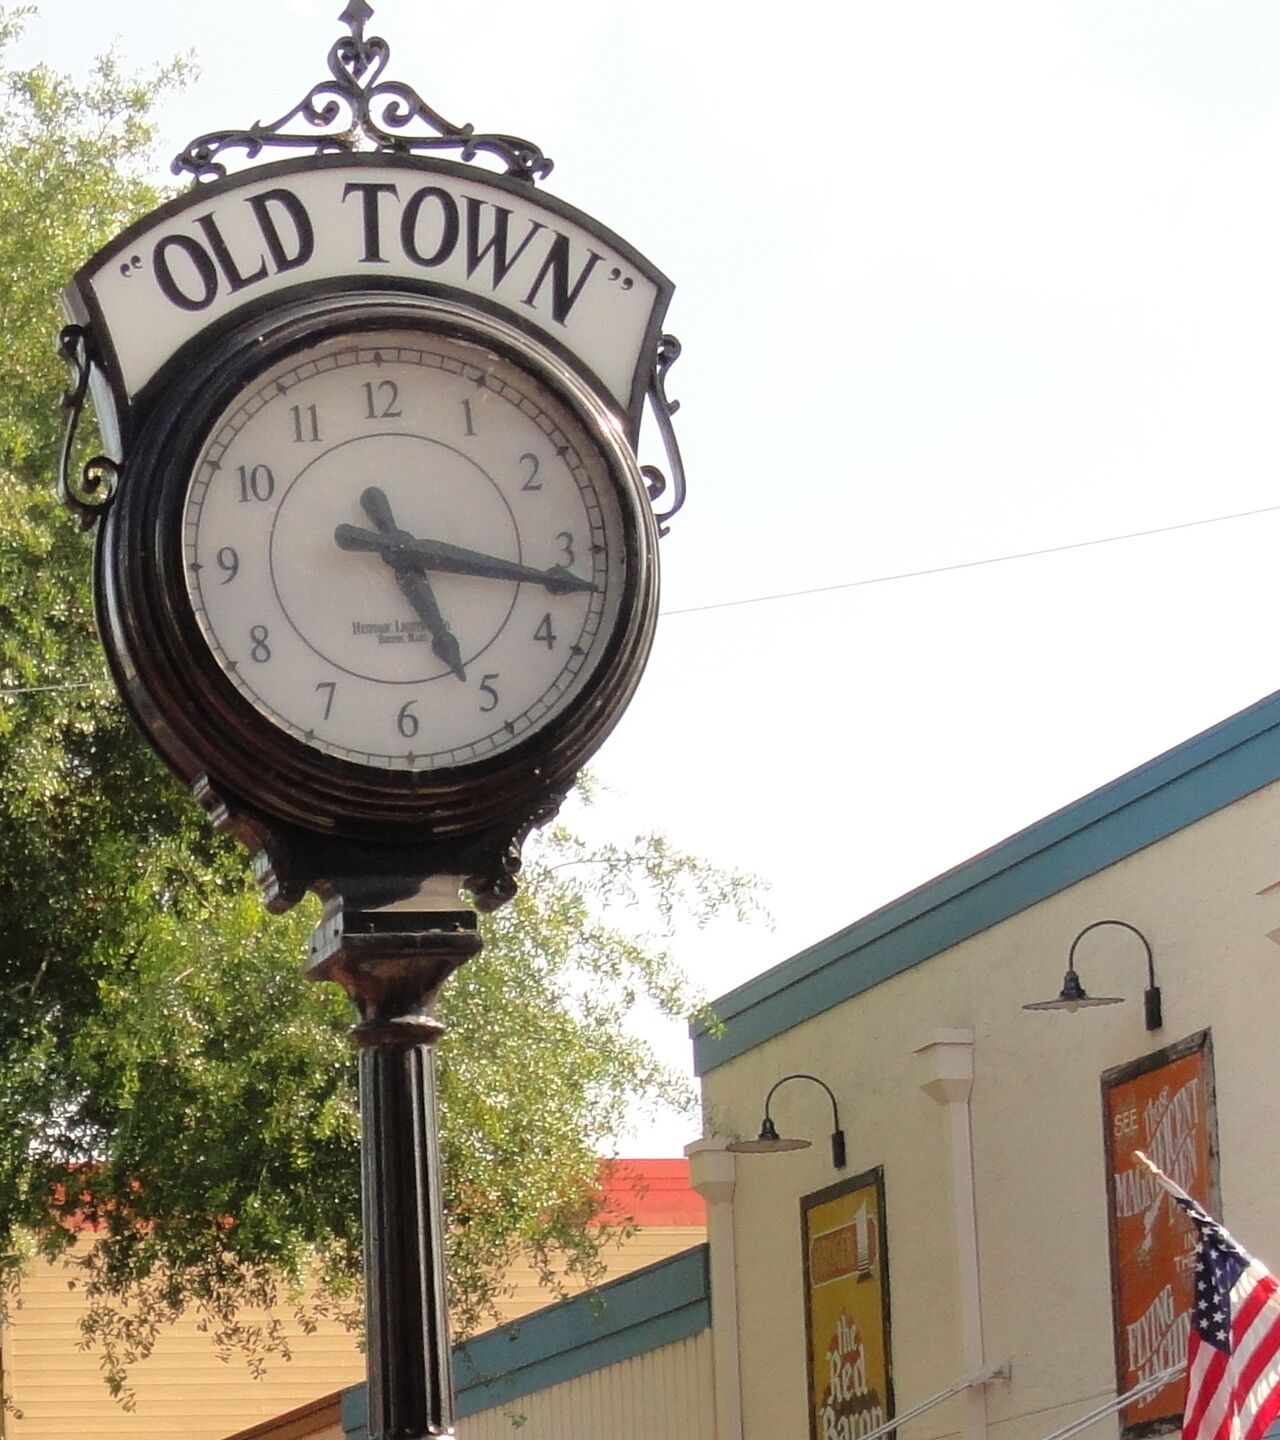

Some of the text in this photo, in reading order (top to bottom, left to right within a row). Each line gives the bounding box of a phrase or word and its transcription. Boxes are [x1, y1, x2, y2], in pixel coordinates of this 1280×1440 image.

[361, 379, 403, 420] 12
[462, 398, 478, 437] 1
[290, 403, 323, 443] 11
[236, 463, 275, 503] 10
[519, 452, 543, 491] 2
[217, 546, 240, 586] 9
[556, 531, 575, 569] 3
[251, 625, 272, 664] 8
[533, 611, 557, 651] 4
[316, 682, 337, 721] 7
[479, 673, 501, 712] 5
[397, 699, 420, 738] 6
[1114, 1108, 1139, 1137] SEE
[826, 1343, 869, 1404] Red
